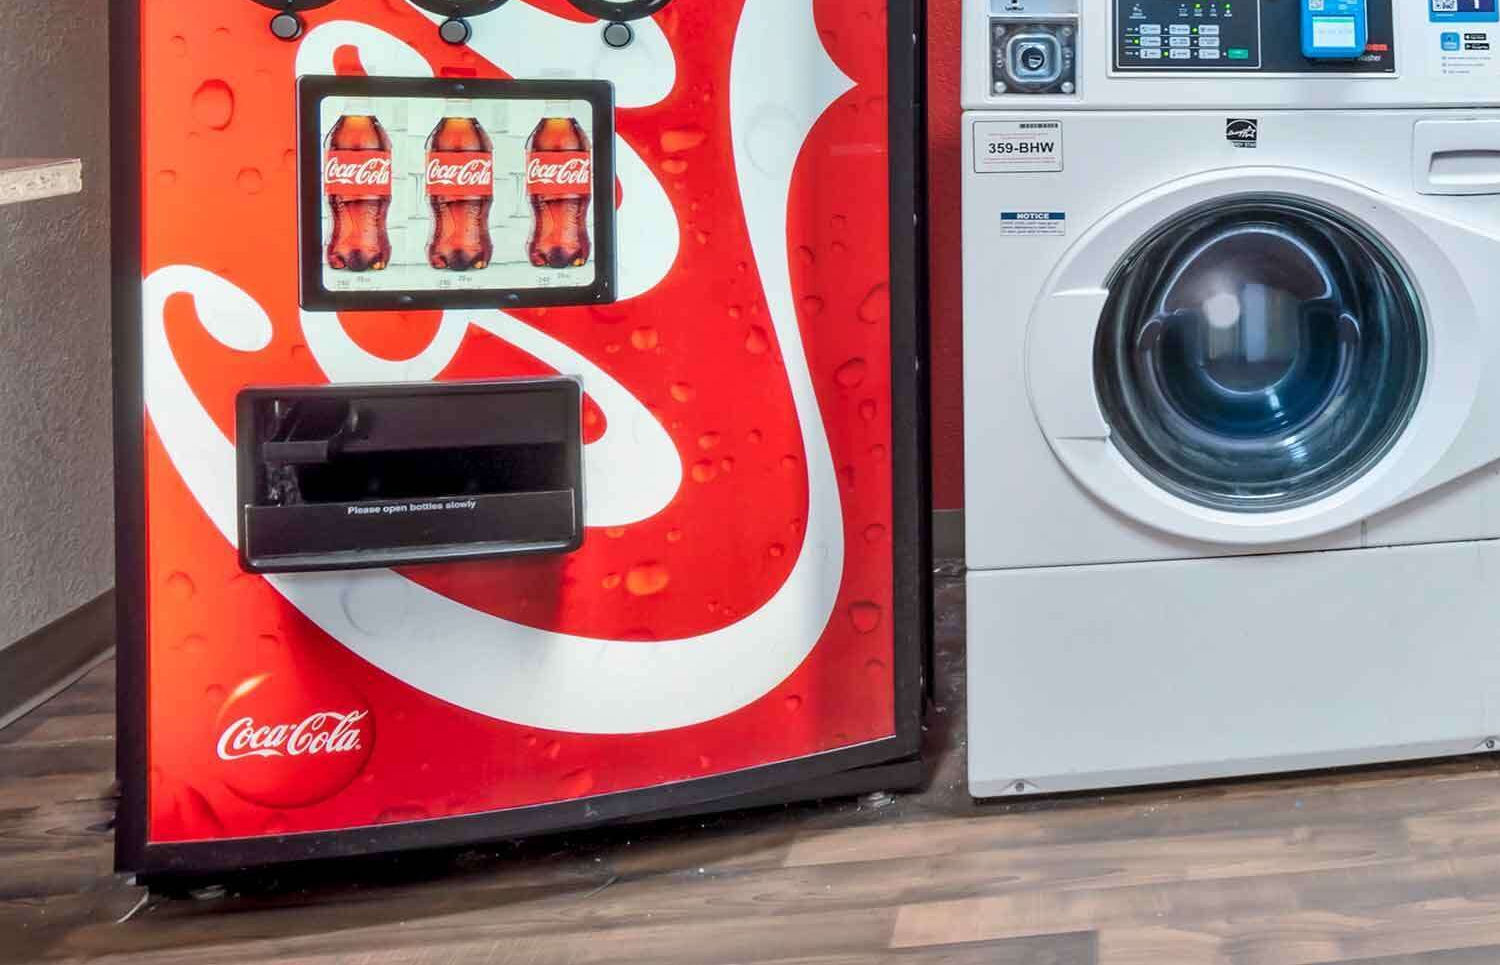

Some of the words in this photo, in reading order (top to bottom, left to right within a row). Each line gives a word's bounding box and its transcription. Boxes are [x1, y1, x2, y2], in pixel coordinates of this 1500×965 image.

[988, 142, 1054, 154] 359-BHW
[325, 157, 391, 185] Coca-Cola
[426, 158, 493, 186] Coca-Cola
[527, 157, 592, 184] Coca-Cola
[1017, 212, 1050, 220] NOTICE
[347, 506, 381, 515] Please
[383, 505, 407, 514] open
[410, 503, 443, 511] bottles
[446, 499, 477, 509] slowly
[216, 710, 368, 760] Coca-Cola
